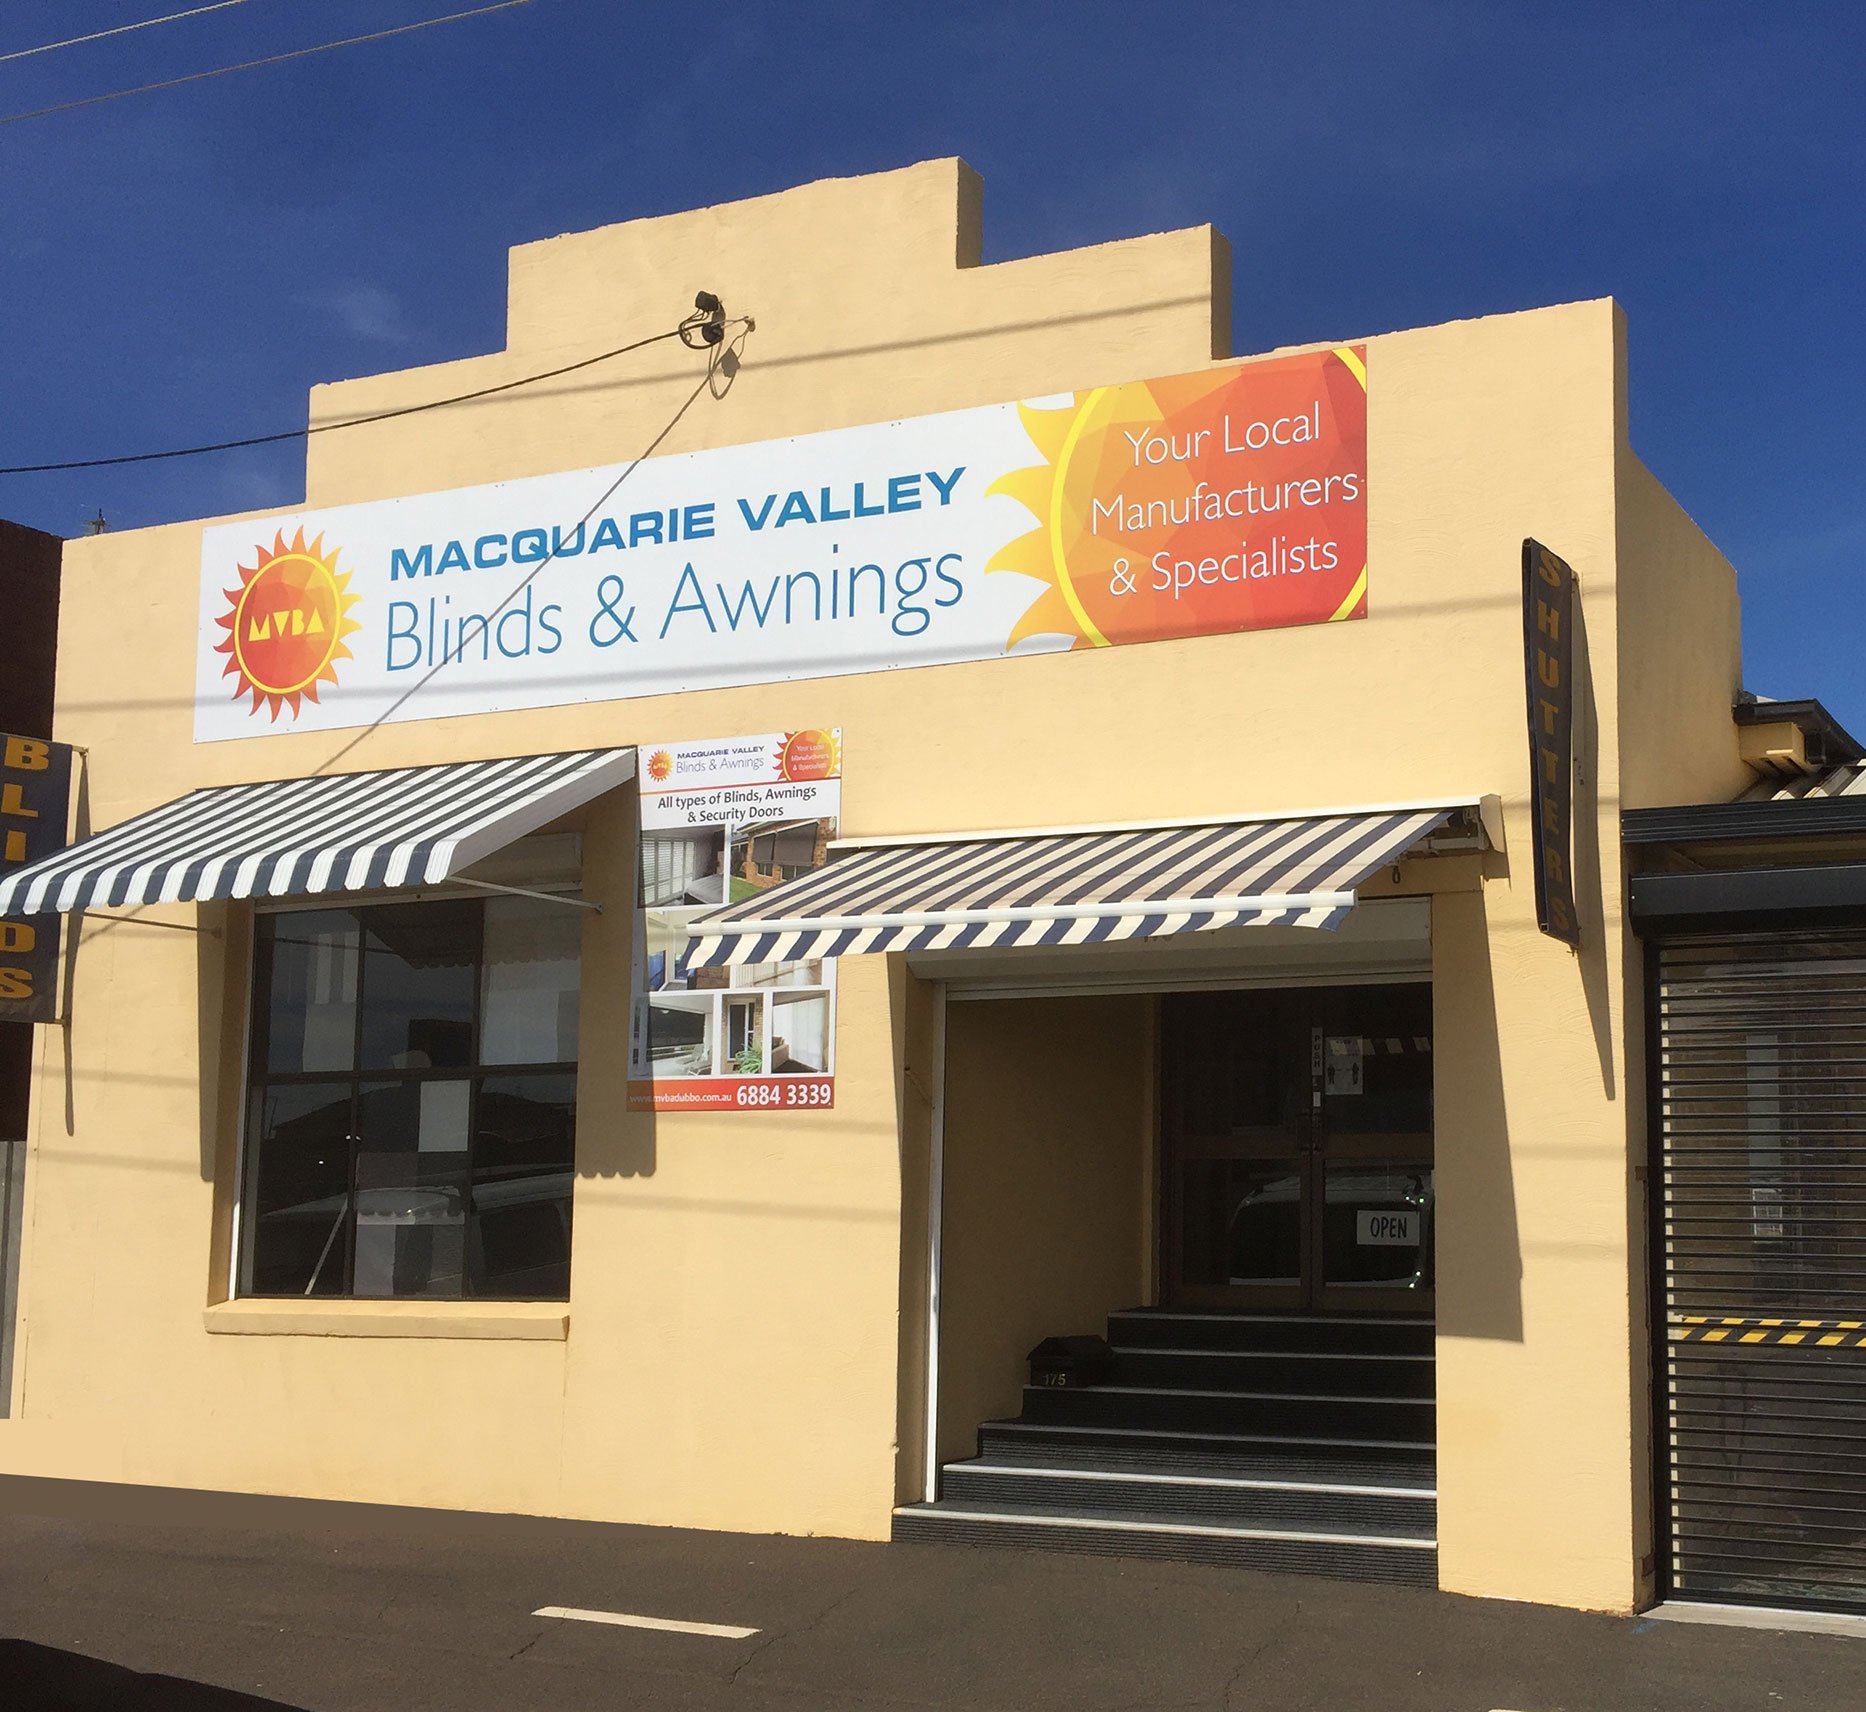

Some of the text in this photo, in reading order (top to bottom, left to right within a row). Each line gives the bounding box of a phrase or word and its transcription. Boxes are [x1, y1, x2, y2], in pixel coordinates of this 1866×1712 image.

[1124, 400, 1320, 467] Your Local
[1092, 472, 1359, 535] Manufacturers
[390, 466, 966, 581] MACQUARIE VALLEY
[1109, 536, 1339, 600] & Specialists
[386, 544, 964, 671] Blinds & Awnings
[248, 607, 325, 642] MVBA
[677, 746, 765, 759] MACQUARIE VALLEY
[1537, 550, 1569, 931] SHUTTERS
[676, 759, 705, 774] Blinds
[708, 758, 718, 771] &
[720, 755, 765, 772] Awnings
[658, 785, 817, 810] All types of Blinds, Awnings
[687, 805, 784, 823] & Security Doors
[736, 1085, 781, 1106] 6884
[786, 1083, 831, 1105] 3339
[1370, 1217, 1407, 1238] OPEN
[1044, 1373, 1066, 1386] 175
